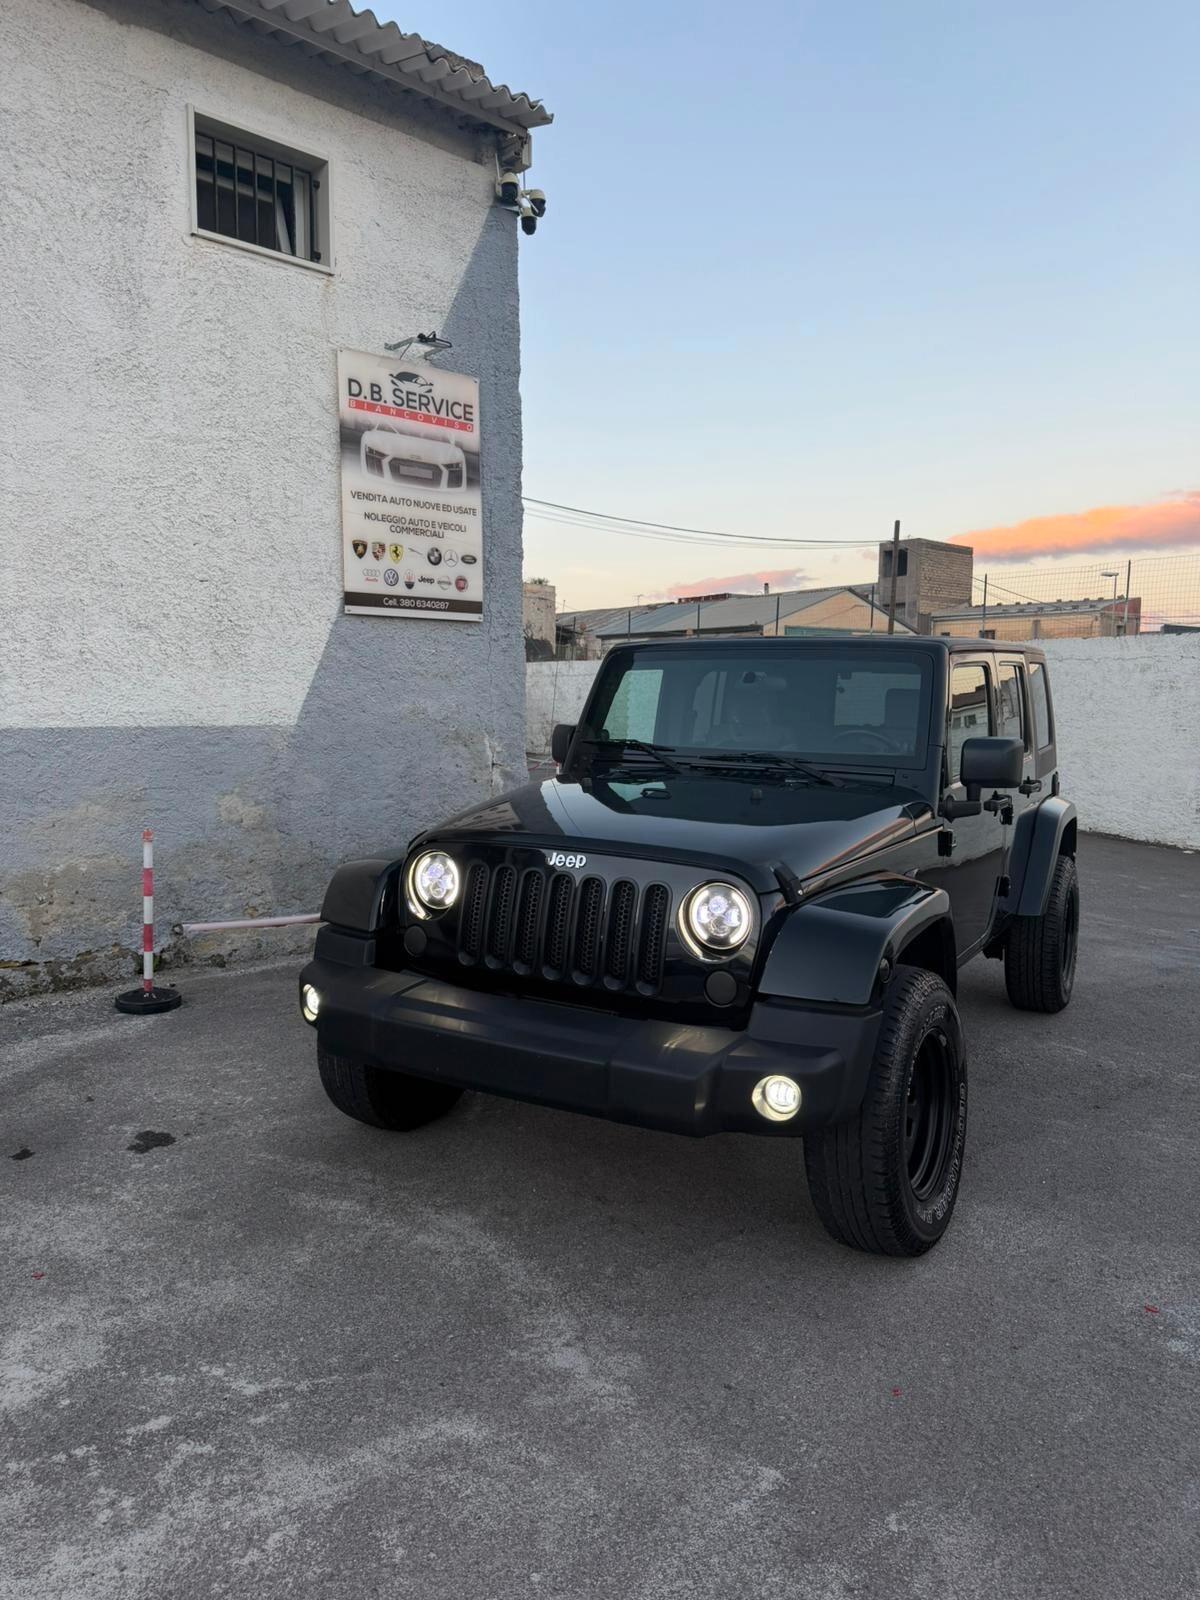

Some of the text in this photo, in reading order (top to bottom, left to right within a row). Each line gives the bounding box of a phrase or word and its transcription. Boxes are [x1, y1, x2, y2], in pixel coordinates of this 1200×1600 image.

[347, 378, 474, 422] D.B. SERVICE
[349, 399, 473, 432] BIANCOVISO
[350, 490, 477, 516] VENDITA AUTO NUOVE ED USATE
[364, 512, 467, 532] NOLEGGIO AUTO E VEICOLI
[389, 525, 445, 539] COMMERCIALI
[547, 852, 587, 869] Jeep
